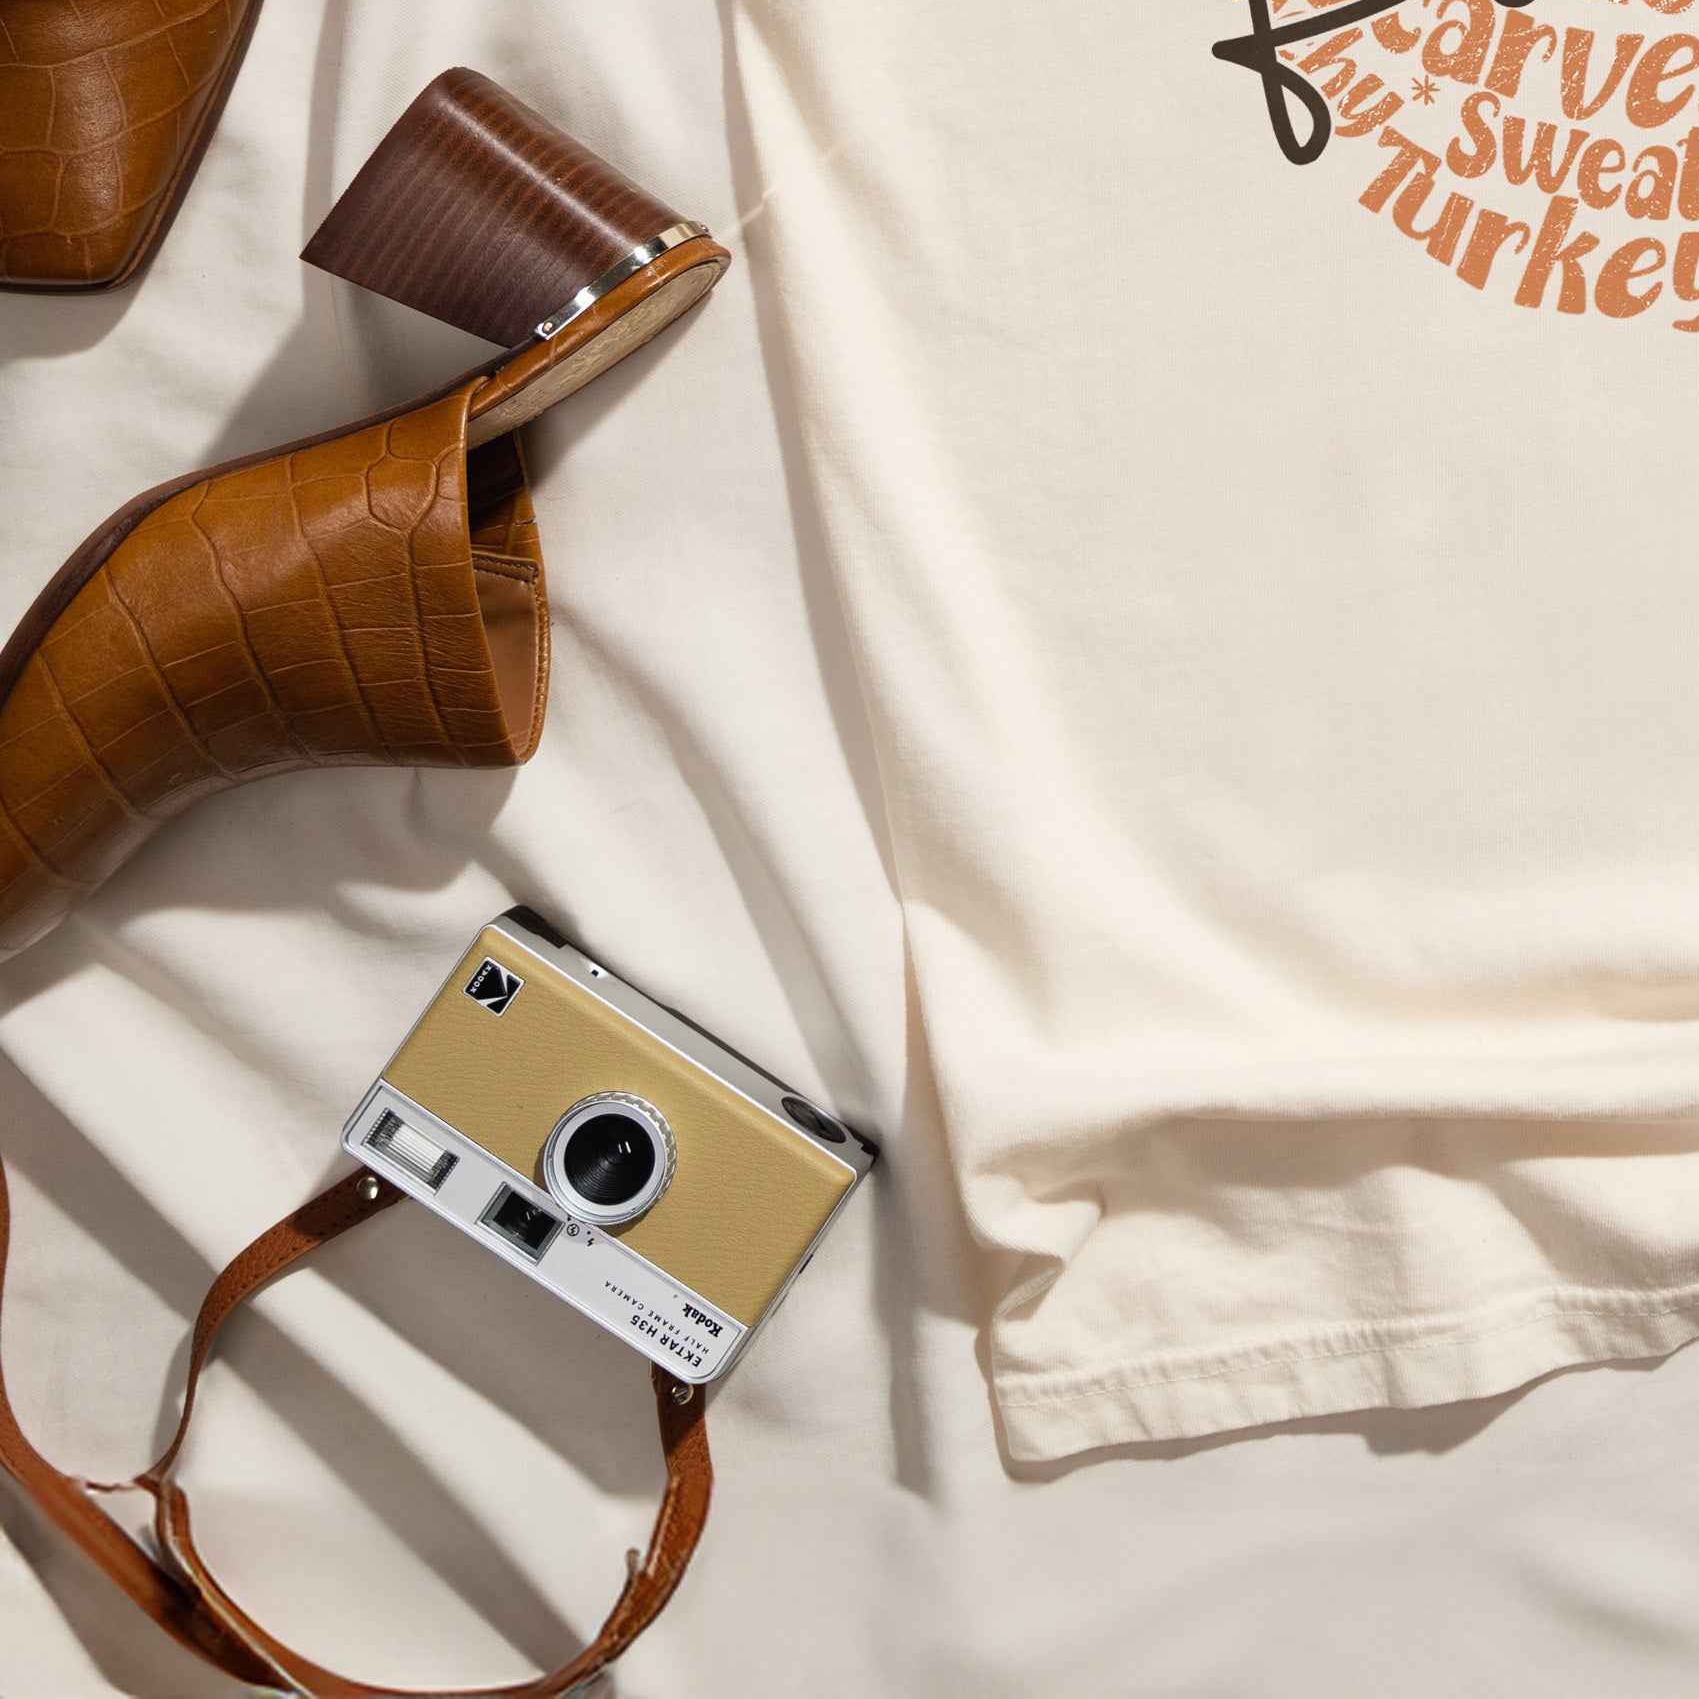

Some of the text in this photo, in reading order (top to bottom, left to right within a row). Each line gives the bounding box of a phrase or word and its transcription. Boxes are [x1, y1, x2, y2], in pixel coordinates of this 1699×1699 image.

[469, 964, 493, 994] KODAK
[604, 1280, 710, 1355] HALF FRAME CAMERA
[682, 1302, 724, 1338] Kodak
[630, 1314, 703, 1368] EKTAR H35
